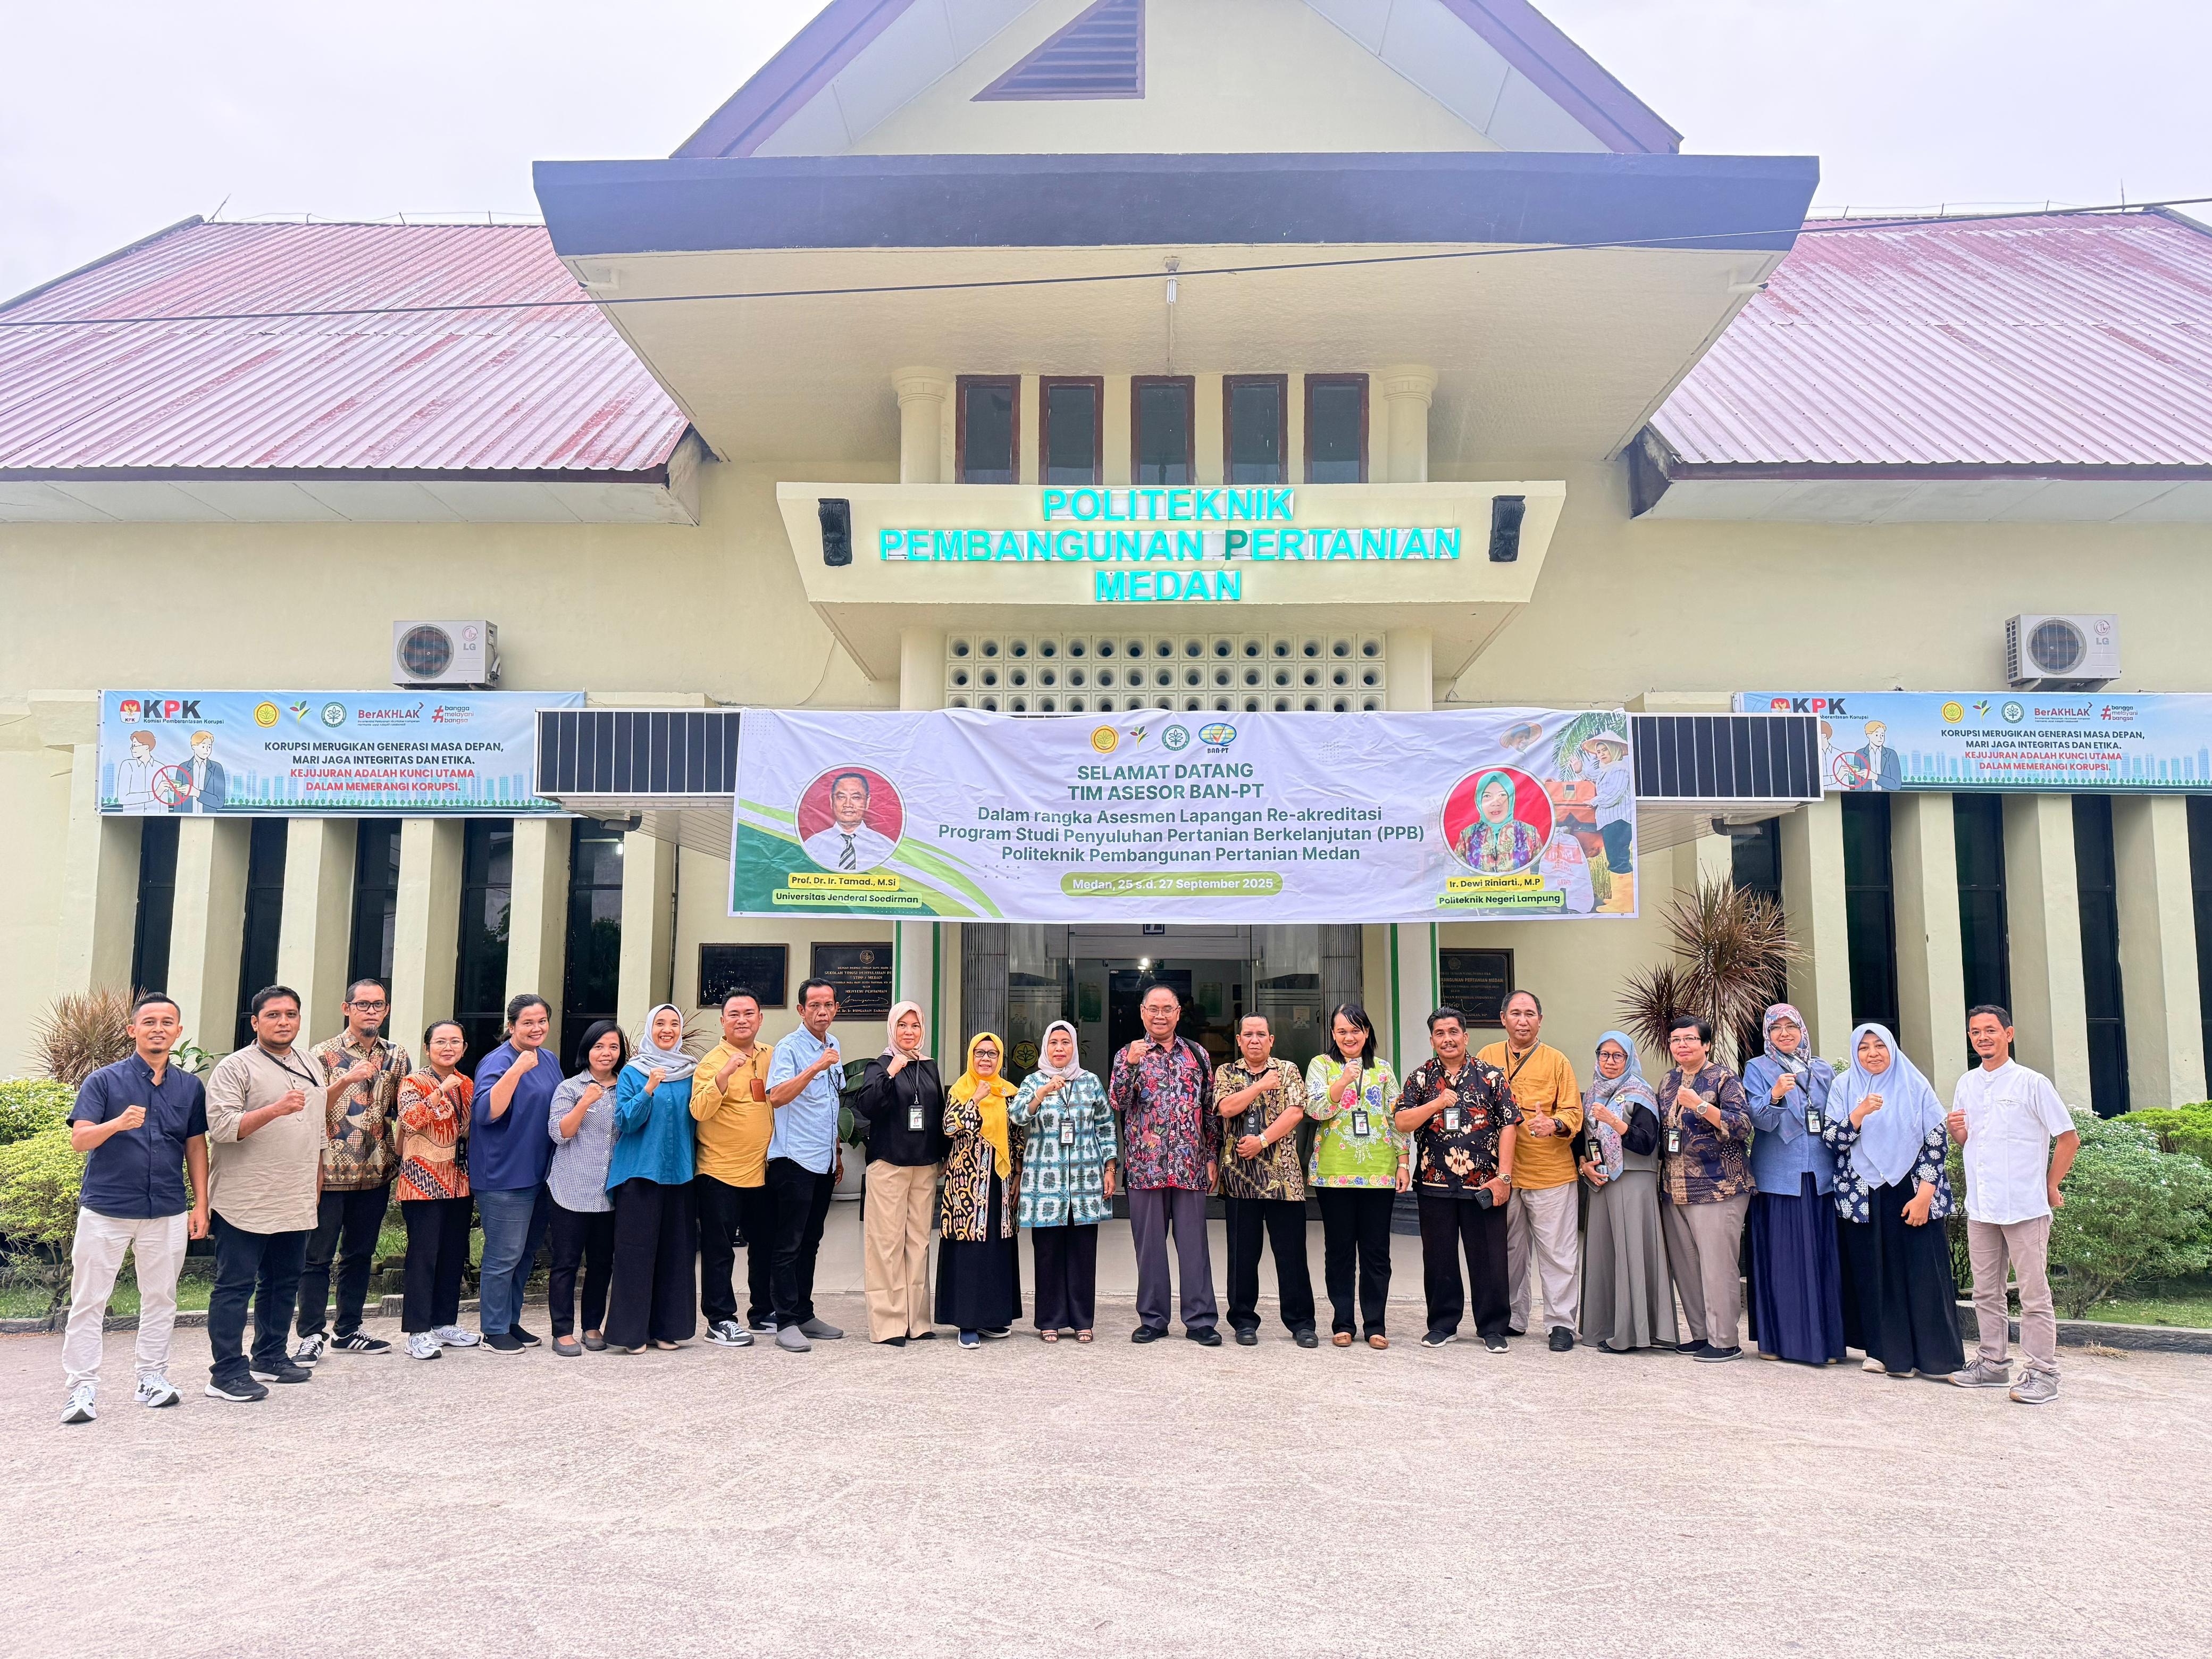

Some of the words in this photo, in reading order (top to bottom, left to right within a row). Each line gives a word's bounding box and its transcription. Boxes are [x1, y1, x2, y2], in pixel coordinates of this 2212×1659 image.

[1043, 488, 1294, 521] POLITEKNIK
[880, 529, 1202, 561] PEMBANGUNAN
[1225, 527, 1461, 560] PERTANIAN
[1095, 570, 1241, 601] MEDAN
[144, 700, 201, 718] KPK
[1792, 698, 1847, 715] KPK
[2034, 708, 2090, 716] BerAKHLAK
[358, 709, 420, 718] BerAKHLAK
[313, 742, 374, 751] MERUGIKAN
[377, 742, 428, 751] GENERASI
[431, 742, 462, 751] MASA
[465, 742, 504, 752] DEPAN,
[293, 756, 319, 764] MARI
[322, 756, 351, 764] JAGA
[354, 756, 413, 764] INTEGRITAS
[290, 769, 351, 777] KEJUJURAN
[354, 769, 397, 777] ADALAH
[400, 769, 433, 777] KUNCI
[436, 769, 475, 777] UTAMA
[1078, 765, 1170, 780] SELAMAT
[1175, 763, 1253, 778] DATANG
[306, 782, 343, 791] DALAM
[346, 782, 409, 791] MEMERANGI
[412, 782, 461, 791] KORUPSI.
[1068, 786, 1102, 800] TIM
[1108, 785, 1185, 800] ASESOR
[1190, 783, 1264, 799] BAN-PT
[978, 807, 1029, 821] Dalam
[1035, 810, 1092, 826] rangka
[1097, 810, 1175, 823] Asesmen
[1180, 809, 1262, 825] Lapangan
[1268, 806, 1381, 821] Re-akreditasi
[939, 824, 1010, 842] Program
[1016, 827, 1059, 842] Studi
[1065, 829, 1163, 846] Penyuluhan
[1168, 827, 1249, 842] Pertanian
[1254, 826, 1371, 843] Berkelanjutan
[1377, 825, 1424, 842] (PPB)
[1002, 847, 1085, 861] Politeknik
[1090, 849, 1211, 865] Pembangunan
[1216, 847, 1297, 860] Pertanian
[1303, 847, 1360, 860] Medan
[839, 877, 875, 886] Tamad.,
[1073, 879, 1115, 891] Medan,
[1118, 880, 1133, 889] 25
[1136, 879, 1157, 889] s.d.
[1159, 879, 1173, 889] 27
[1176, 879, 1240, 891] September
[1243, 878, 1273, 888] 2025
[1485, 878, 1522, 887] Riniarti.,
[776, 892, 825, 901] Universitas
[827, 893, 867, 902] Jenderal
[869, 894, 918, 903] Soedirman
[1439, 895, 1484, 904] Politeknik
[1486, 894, 1515, 904] Negeri
[1517, 895, 1560, 904] Lampung
